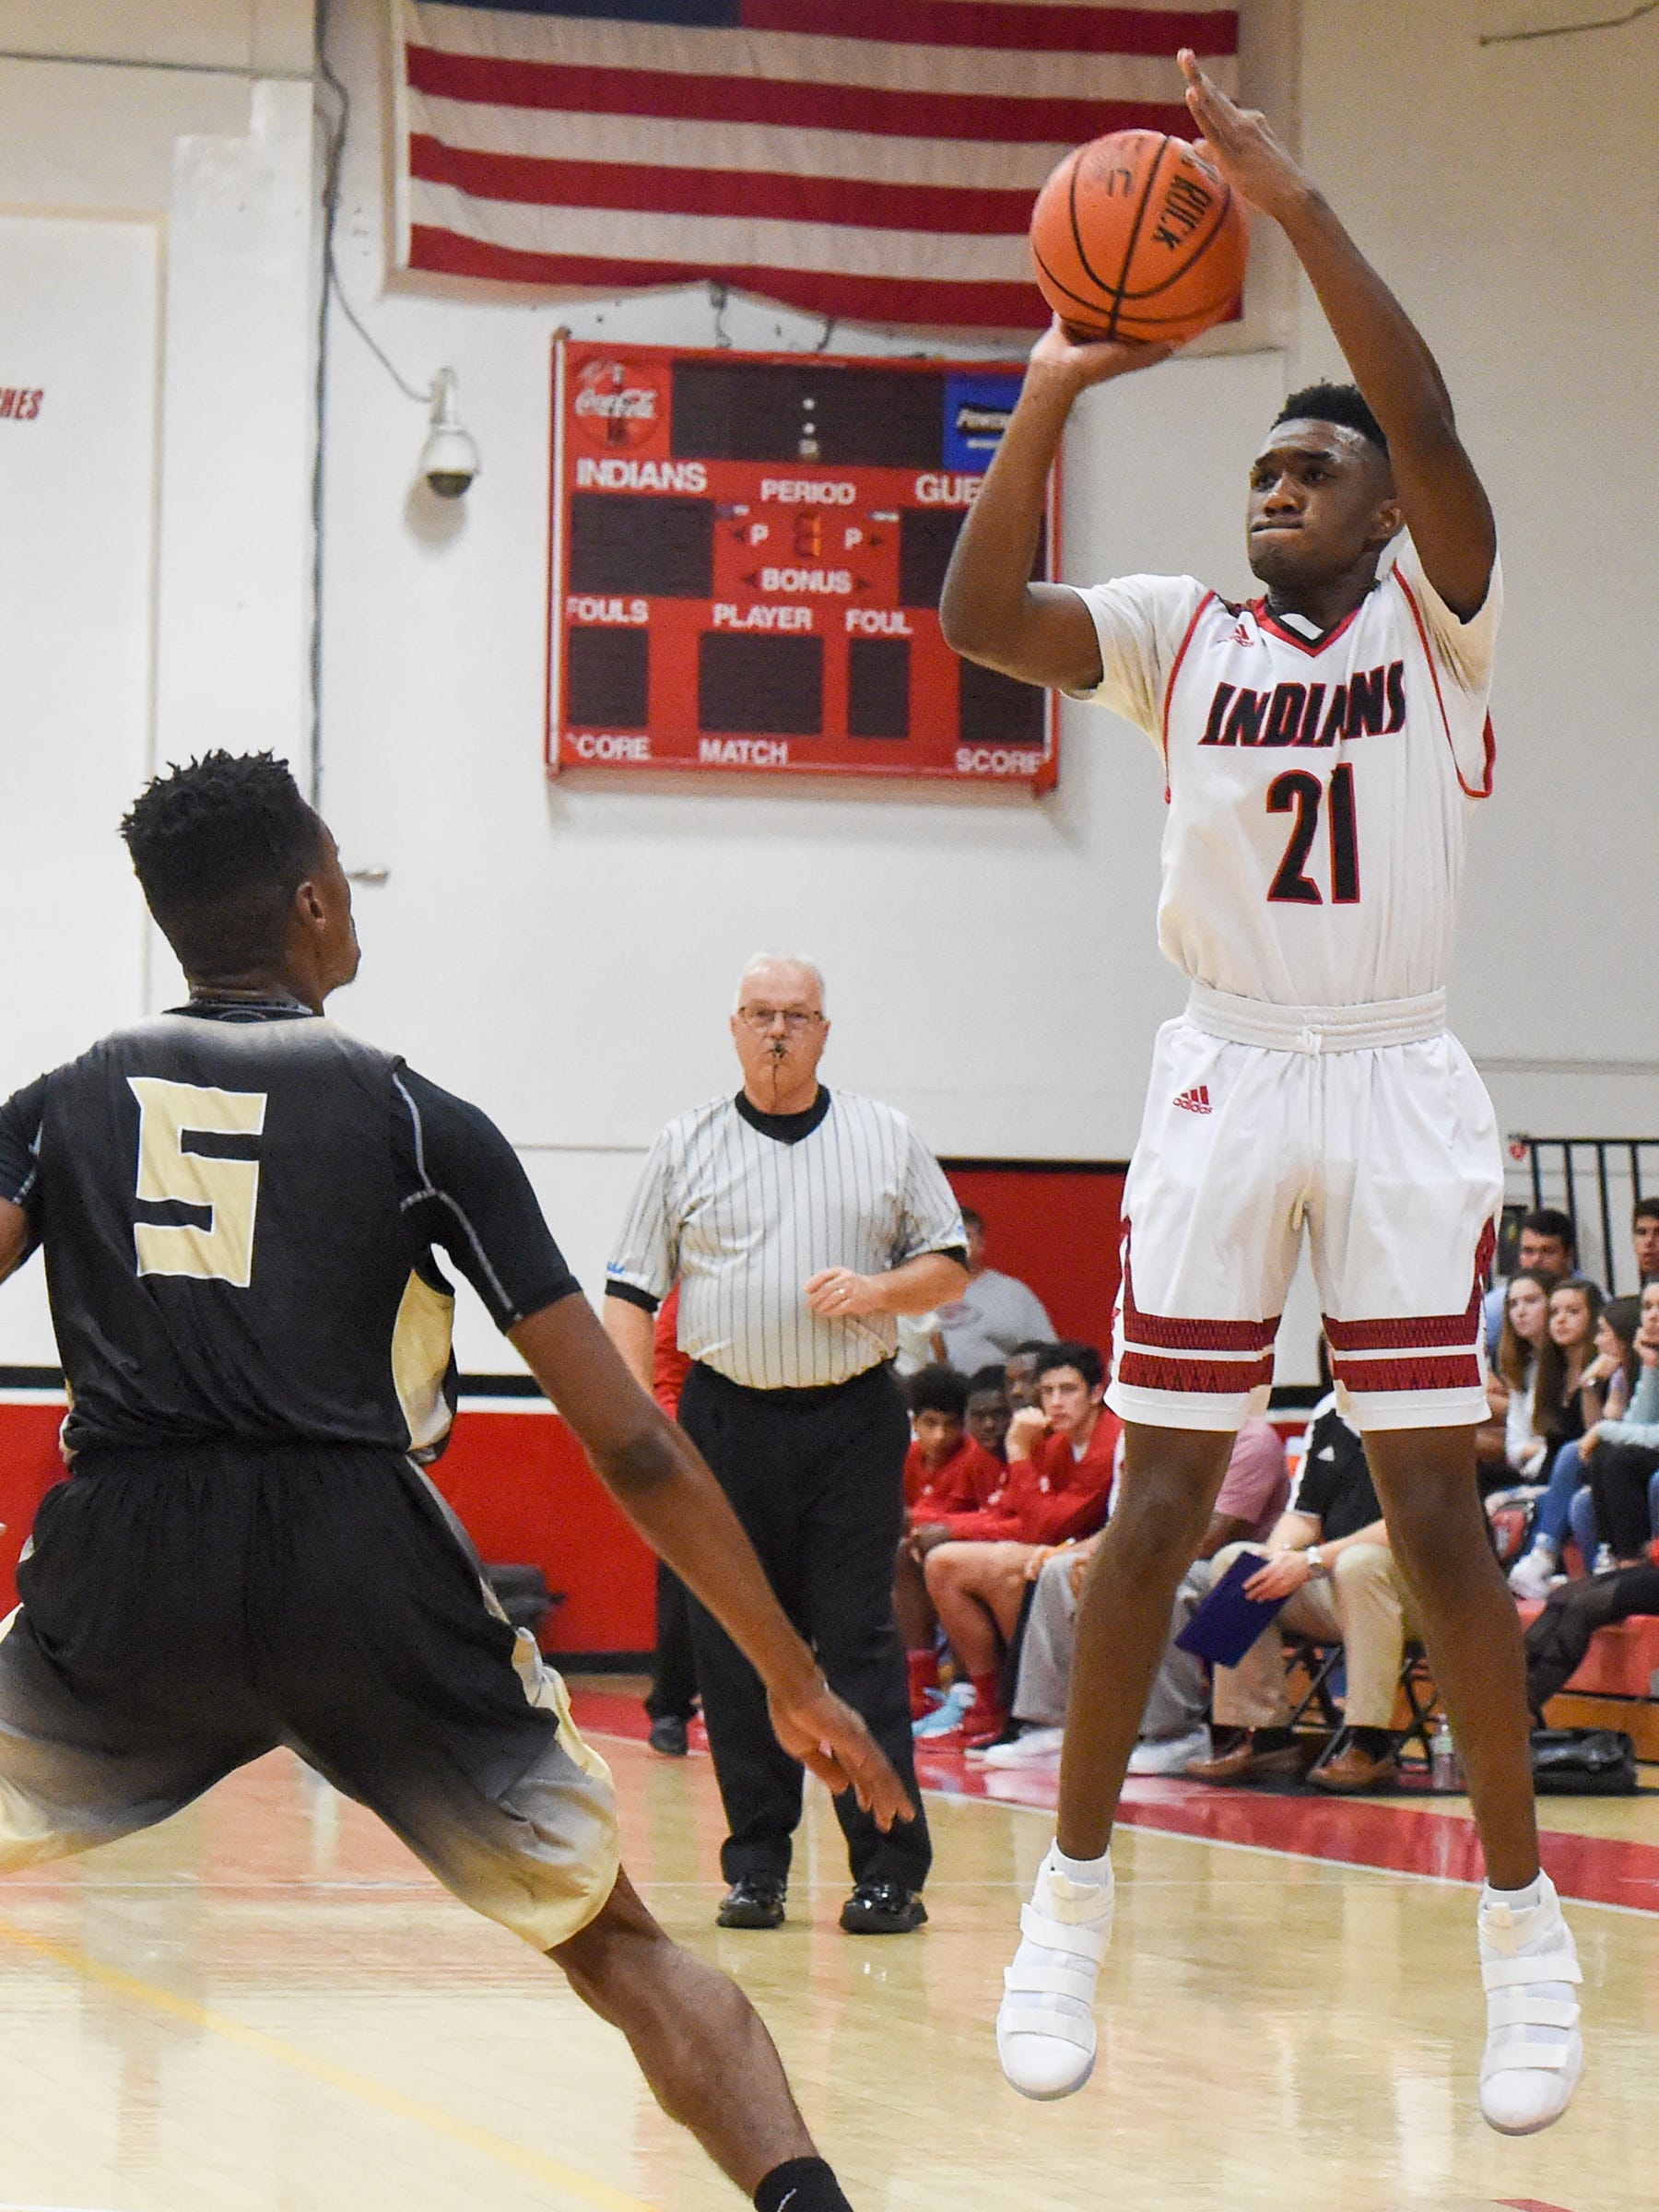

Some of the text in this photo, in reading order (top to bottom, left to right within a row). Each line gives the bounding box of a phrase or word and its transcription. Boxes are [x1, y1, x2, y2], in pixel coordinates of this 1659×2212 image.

[0, 388, 43, 420] HES
[576, 458, 707, 492] INDIANS
[760, 479, 856, 505] PERIOD
[750, 523, 769, 546] P
[844, 527, 863, 549] P
[760, 568, 852, 594] BONUS
[712, 604, 813, 629] PLAYER
[845, 608, 912, 634] FOUL
[1198, 660, 1406, 747] INDIANS
[699, 738, 788, 764] MATCH
[1266, 762, 1360, 905] 21
[127, 1077, 267, 1288] 5
